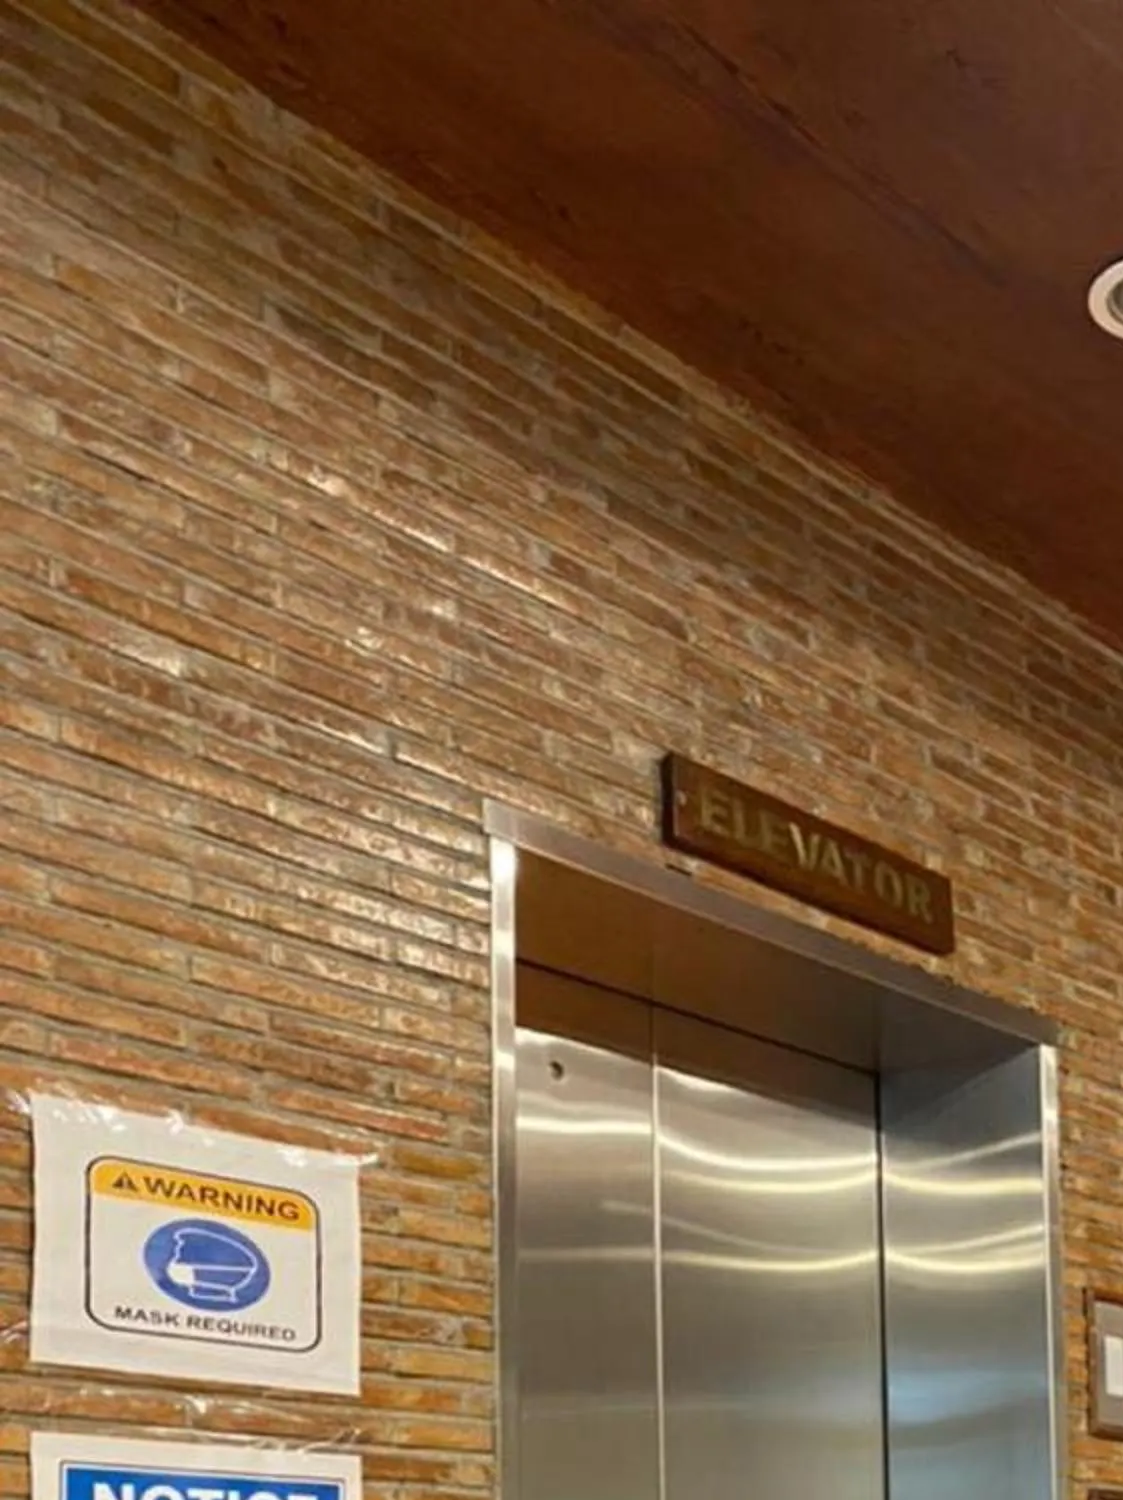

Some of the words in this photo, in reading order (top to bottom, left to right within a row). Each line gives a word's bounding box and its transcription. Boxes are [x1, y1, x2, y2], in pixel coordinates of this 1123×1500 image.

[697, 786, 936, 926] ELEVATOR
[143, 1175, 302, 1222] WARNING
[114, 1305, 180, 1327] MASK
[187, 1314, 297, 1342] REQUIRED
